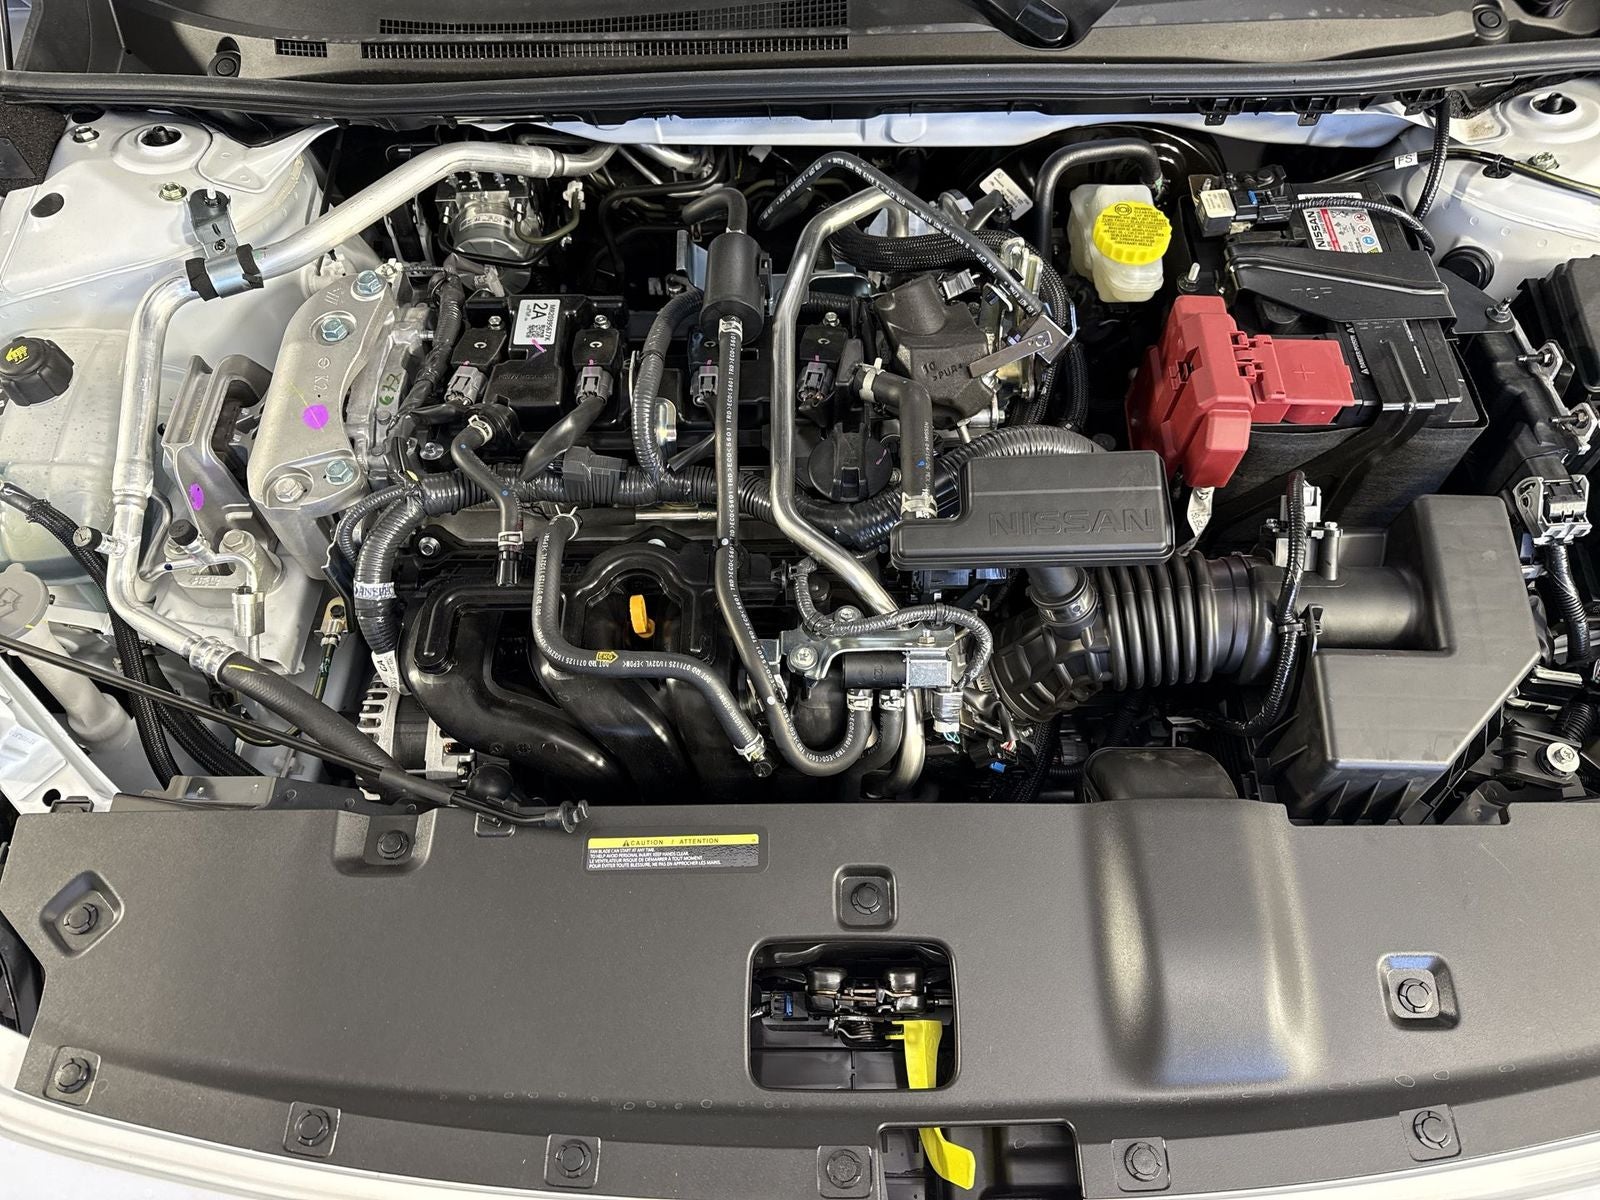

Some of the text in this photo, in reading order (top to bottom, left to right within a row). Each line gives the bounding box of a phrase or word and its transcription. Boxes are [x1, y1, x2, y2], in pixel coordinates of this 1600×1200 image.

[1396, 154, 1414, 166] FS
[1306, 211, 1327, 248] NISSAN
[531, 302, 549, 320] 2A
[988, 508, 1154, 536] NISSAN
